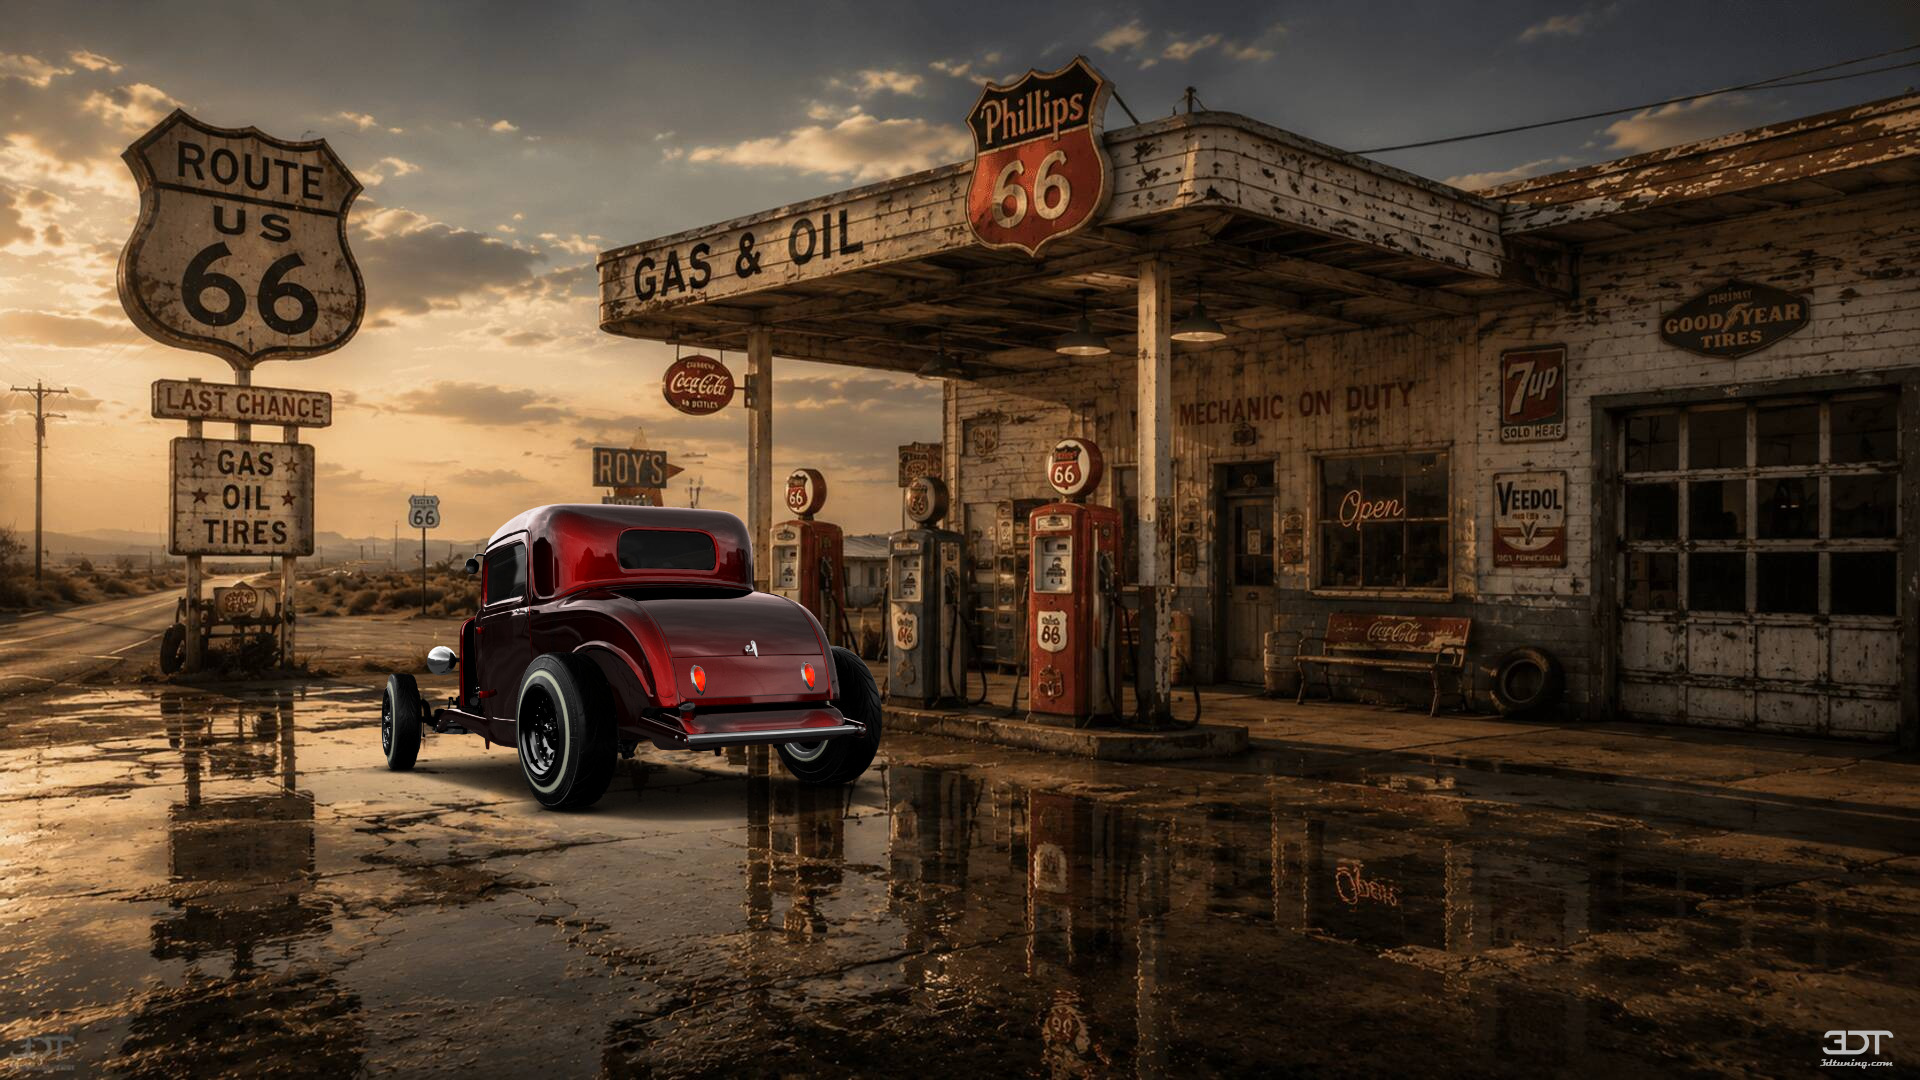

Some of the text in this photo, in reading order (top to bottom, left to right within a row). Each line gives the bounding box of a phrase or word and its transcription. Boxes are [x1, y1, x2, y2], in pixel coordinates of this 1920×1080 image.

[980, 90, 1083, 145] Phillips
[177, 141, 324, 201] ROUTE
[991, 150, 1071, 228] 66
[213, 205, 292, 243] US
[634, 208, 863, 302] GAS & OIL
[181, 241, 319, 336] 66
[1701, 330, 1762, 349] TIRES
[167, 387, 324, 419] LAST CHANCE
[1180, 381, 1415, 426] MECHANIC ON DUTY
[1504, 424, 1561, 439] SOLD HERE
[217, 450, 274, 476] GAS
[600, 451, 663, 484] ROY'S
[1054, 465, 1075, 484] 66
[222, 484, 270, 510] OIL
[789, 490, 803, 505] 66
[1340, 490, 1404, 532] Open
[1497, 482, 1562, 516] VEEDOL
[203, 519, 287, 545] TIRES
[414, 510, 435, 525] 66
